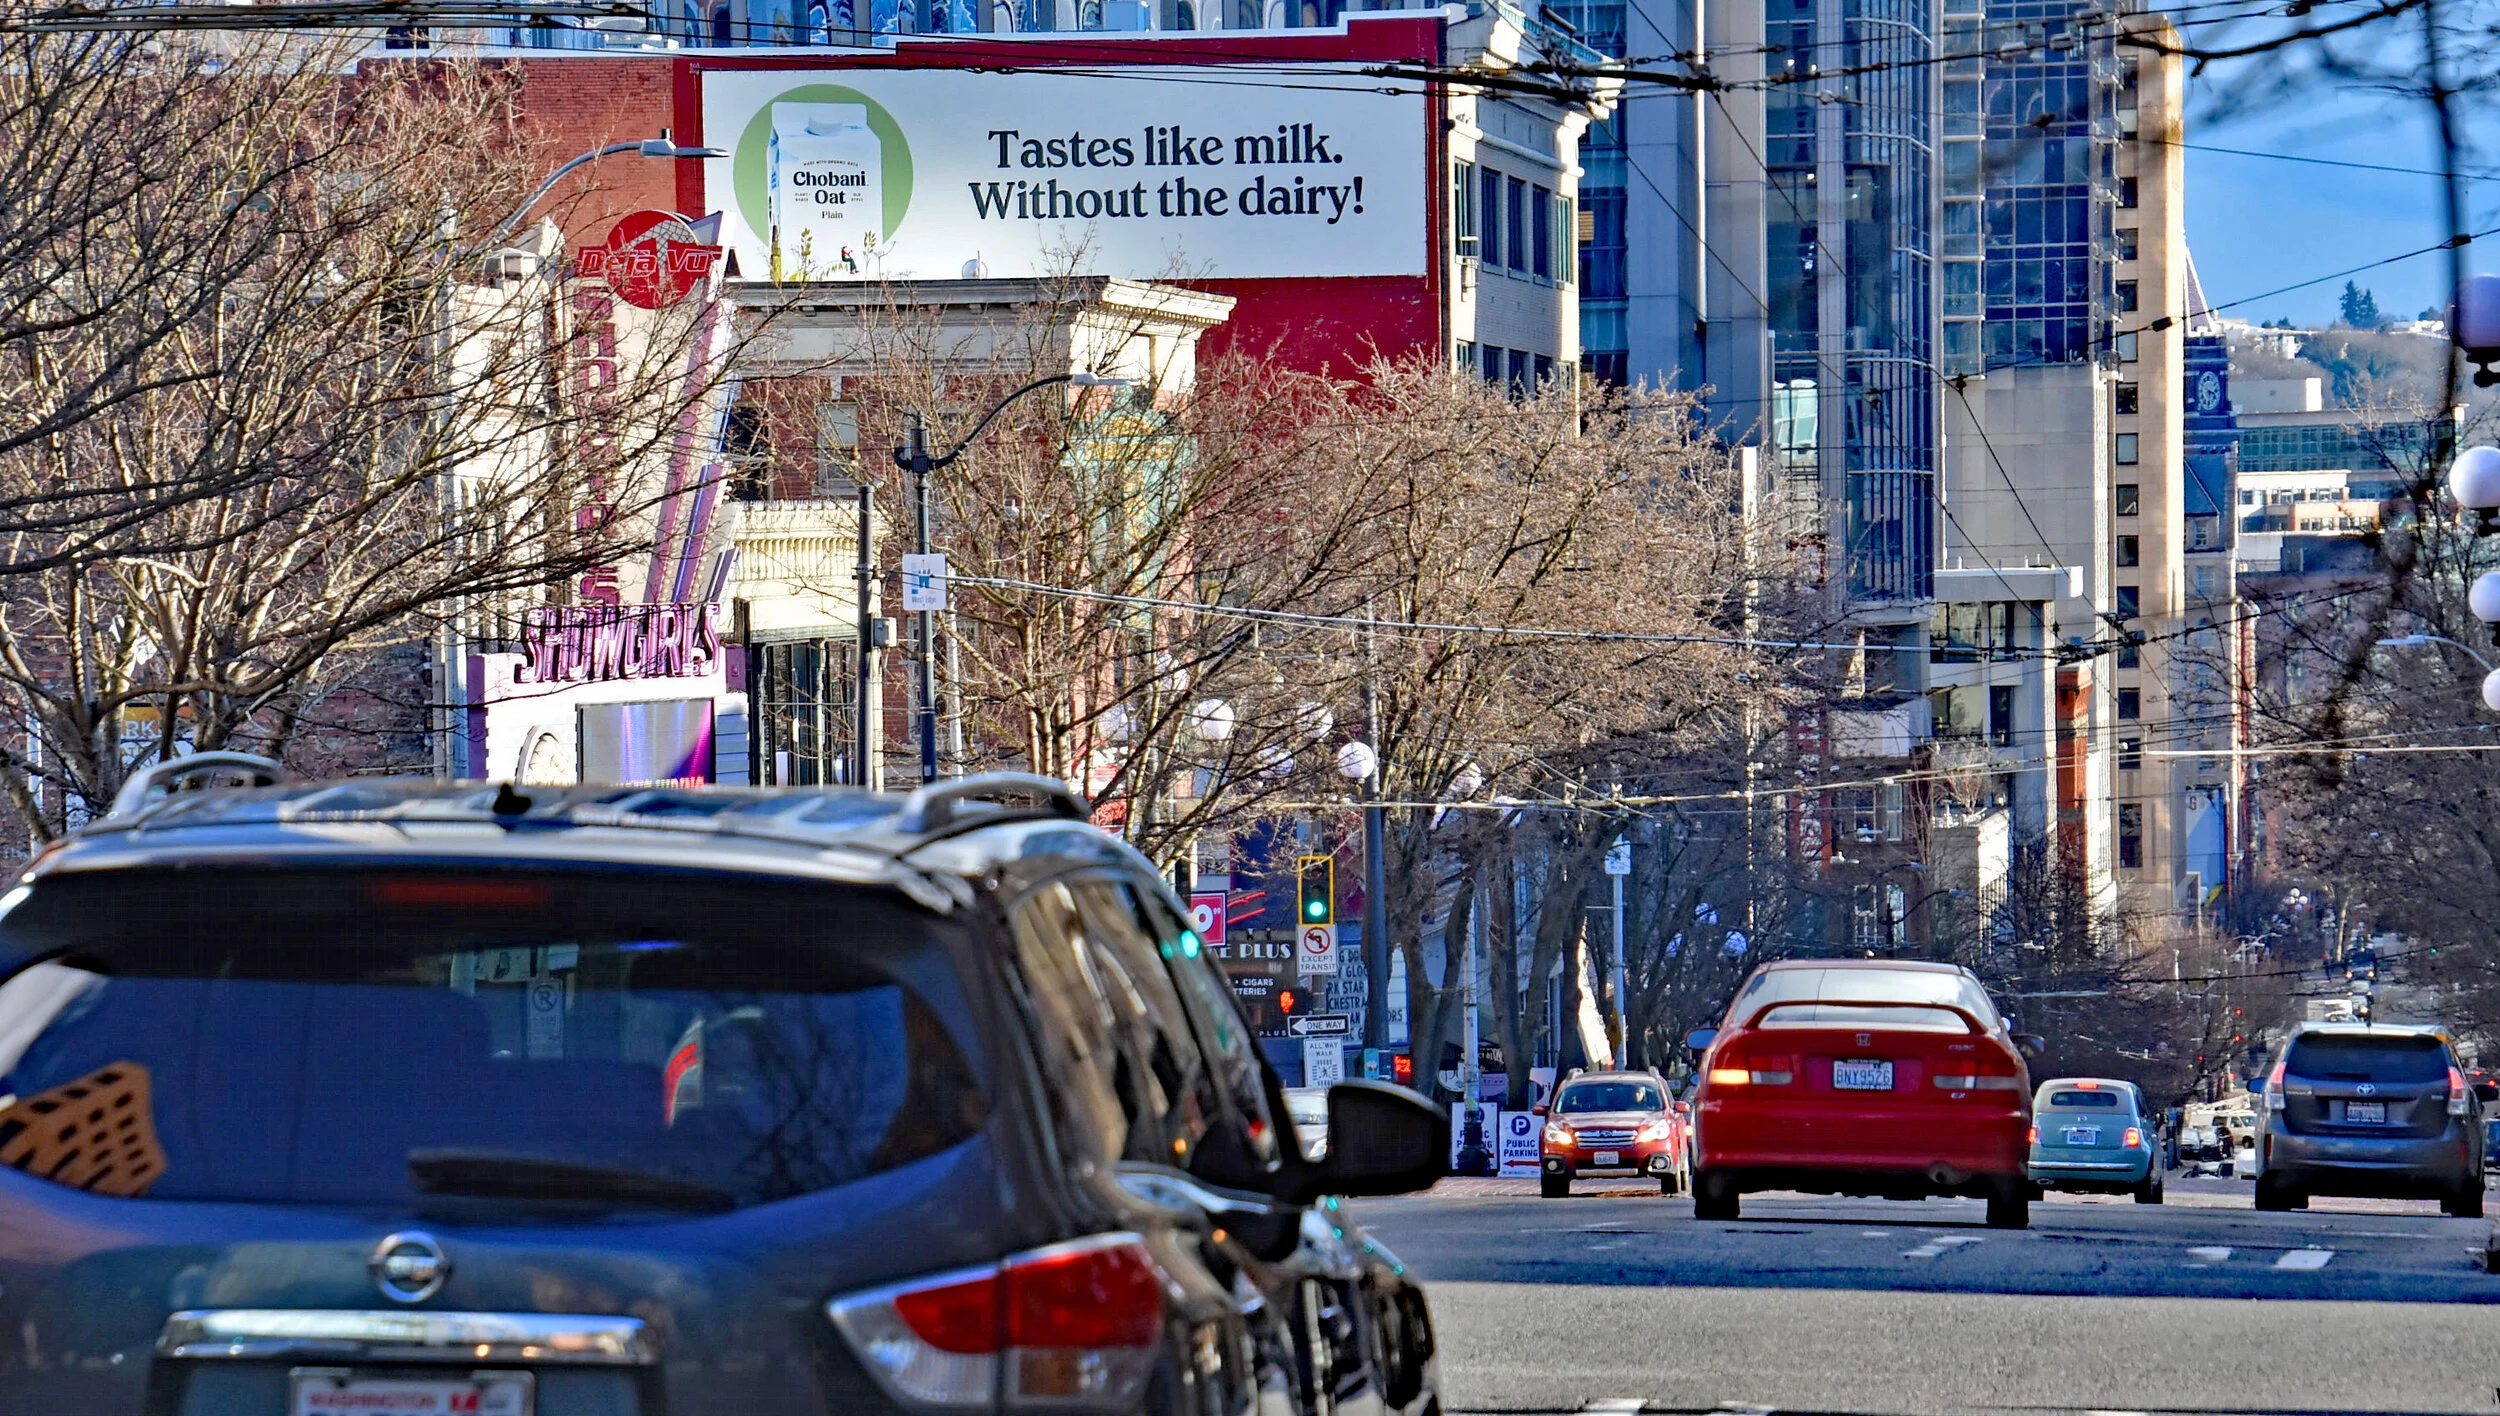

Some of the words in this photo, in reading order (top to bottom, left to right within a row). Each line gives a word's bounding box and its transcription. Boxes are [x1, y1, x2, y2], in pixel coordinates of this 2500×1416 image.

[988, 130, 1134, 168] Tastes
[1144, 125, 1224, 166] like
[1234, 123, 1344, 164] milk.
[793, 171, 866, 186] Chobani
[815, 189, 846, 205] Oat
[968, 177, 1148, 219] Without
[1157, 177, 1229, 217] the
[1238, 175, 1365, 224] dairy!
[821, 211, 843, 219] Plain
[514, 603, 721, 684] SHOWGIRLS
[1239, 943, 1292, 959] PLUS
[1301, 955, 1334, 963] EXCEPT
[1300, 963, 1336, 971] TRANSIT
[1242, 978, 1274, 986] CIGARS
[1342, 981, 1365, 995] STAR
[1307, 1020, 1324, 1030] ONE
[1325, 1019, 1343, 1029] WAY
[1258, 1029, 1287, 1037] PLUS
[1325, 1041, 1339, 1049] WAY
[1836, 1068, 1891, 1085] BNY9526
[1506, 1139, 1536, 1148] PUBLIC
[1503, 1149, 1538, 1157] PARKING
[310, 1393, 438, 1409] WASHINGTON
